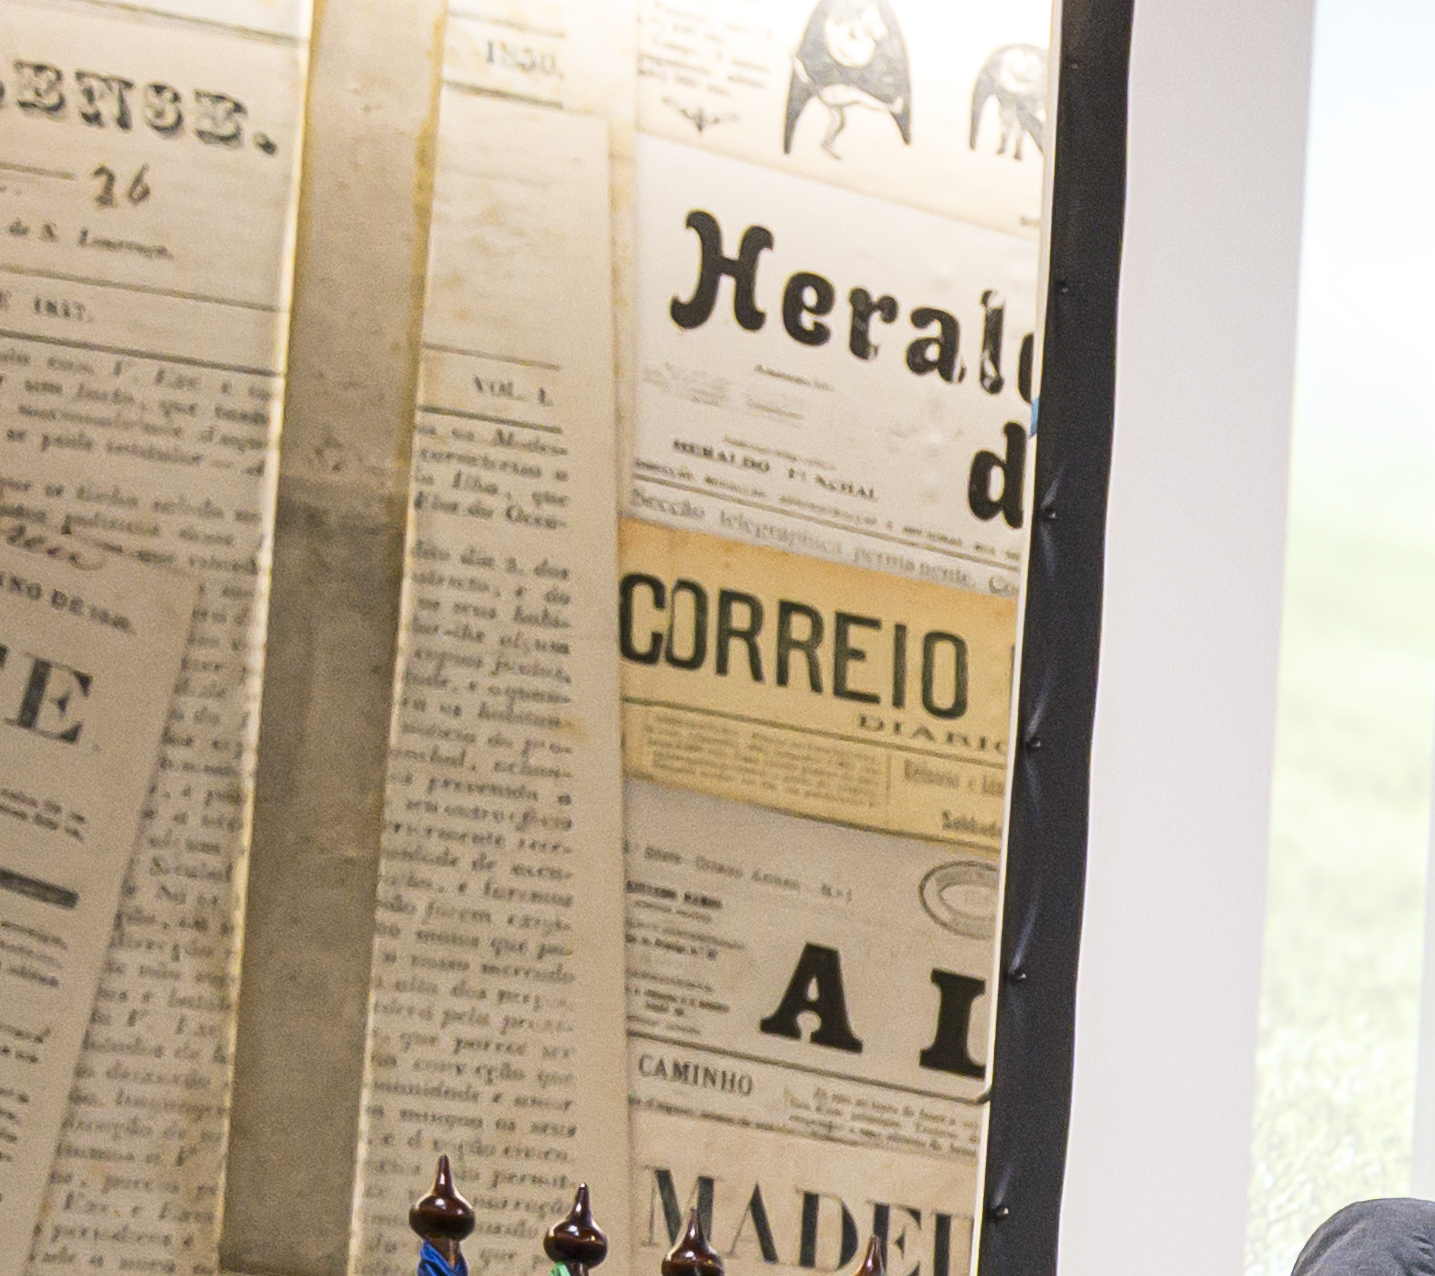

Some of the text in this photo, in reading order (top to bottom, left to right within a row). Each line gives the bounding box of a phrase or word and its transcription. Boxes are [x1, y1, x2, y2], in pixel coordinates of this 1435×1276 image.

[618, 572, 969, 721] CORREIO
[760, 942, 862, 1053] A
[637, 1053, 753, 1098] CAMINHO
